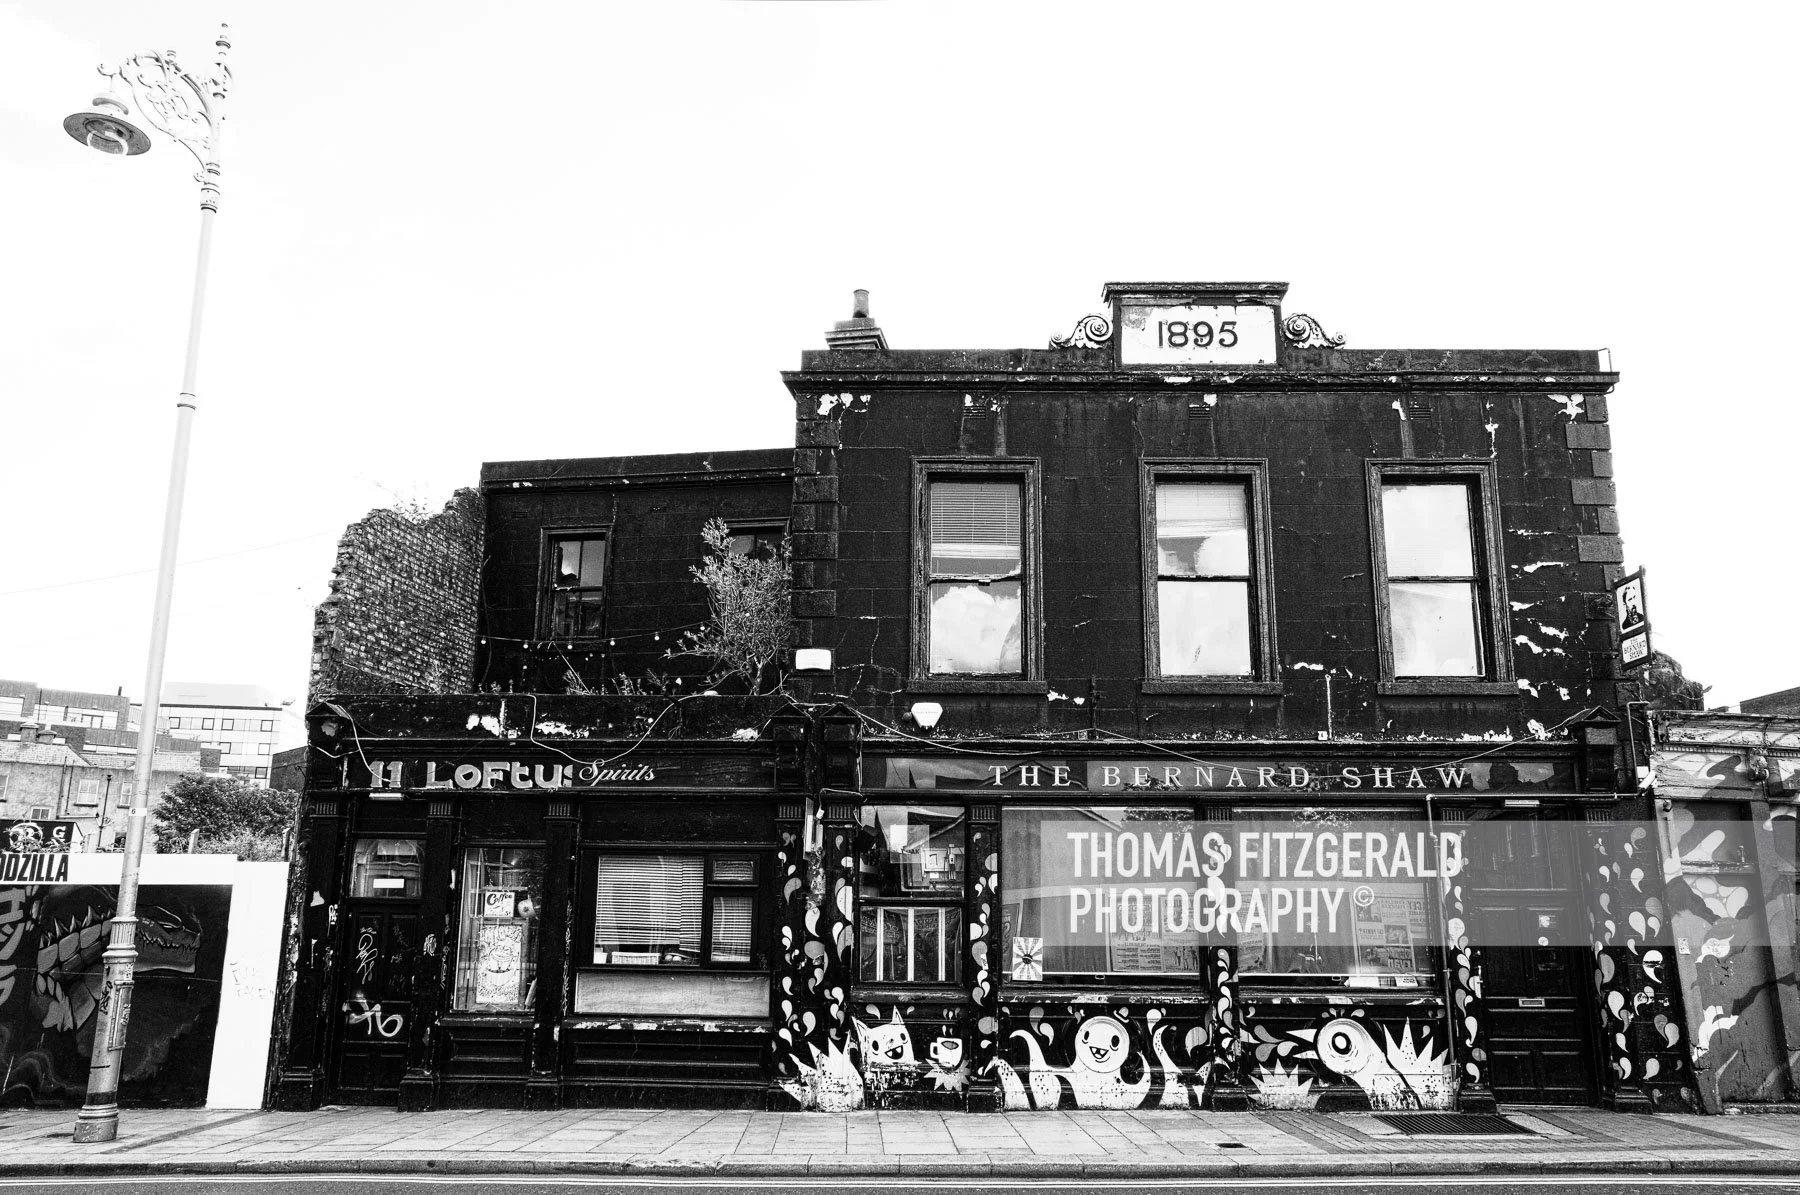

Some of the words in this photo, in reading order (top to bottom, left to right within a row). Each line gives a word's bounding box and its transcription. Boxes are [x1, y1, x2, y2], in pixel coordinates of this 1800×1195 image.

[1157, 320, 1238, 348] 1895
[579, 758, 655, 787] Spirits
[988, 765, 1071, 787] THE
[1101, 765, 1310, 788] BERNARD
[1343, 766, 1467, 789] SHAW
[487, 893, 513, 906] Coffee
